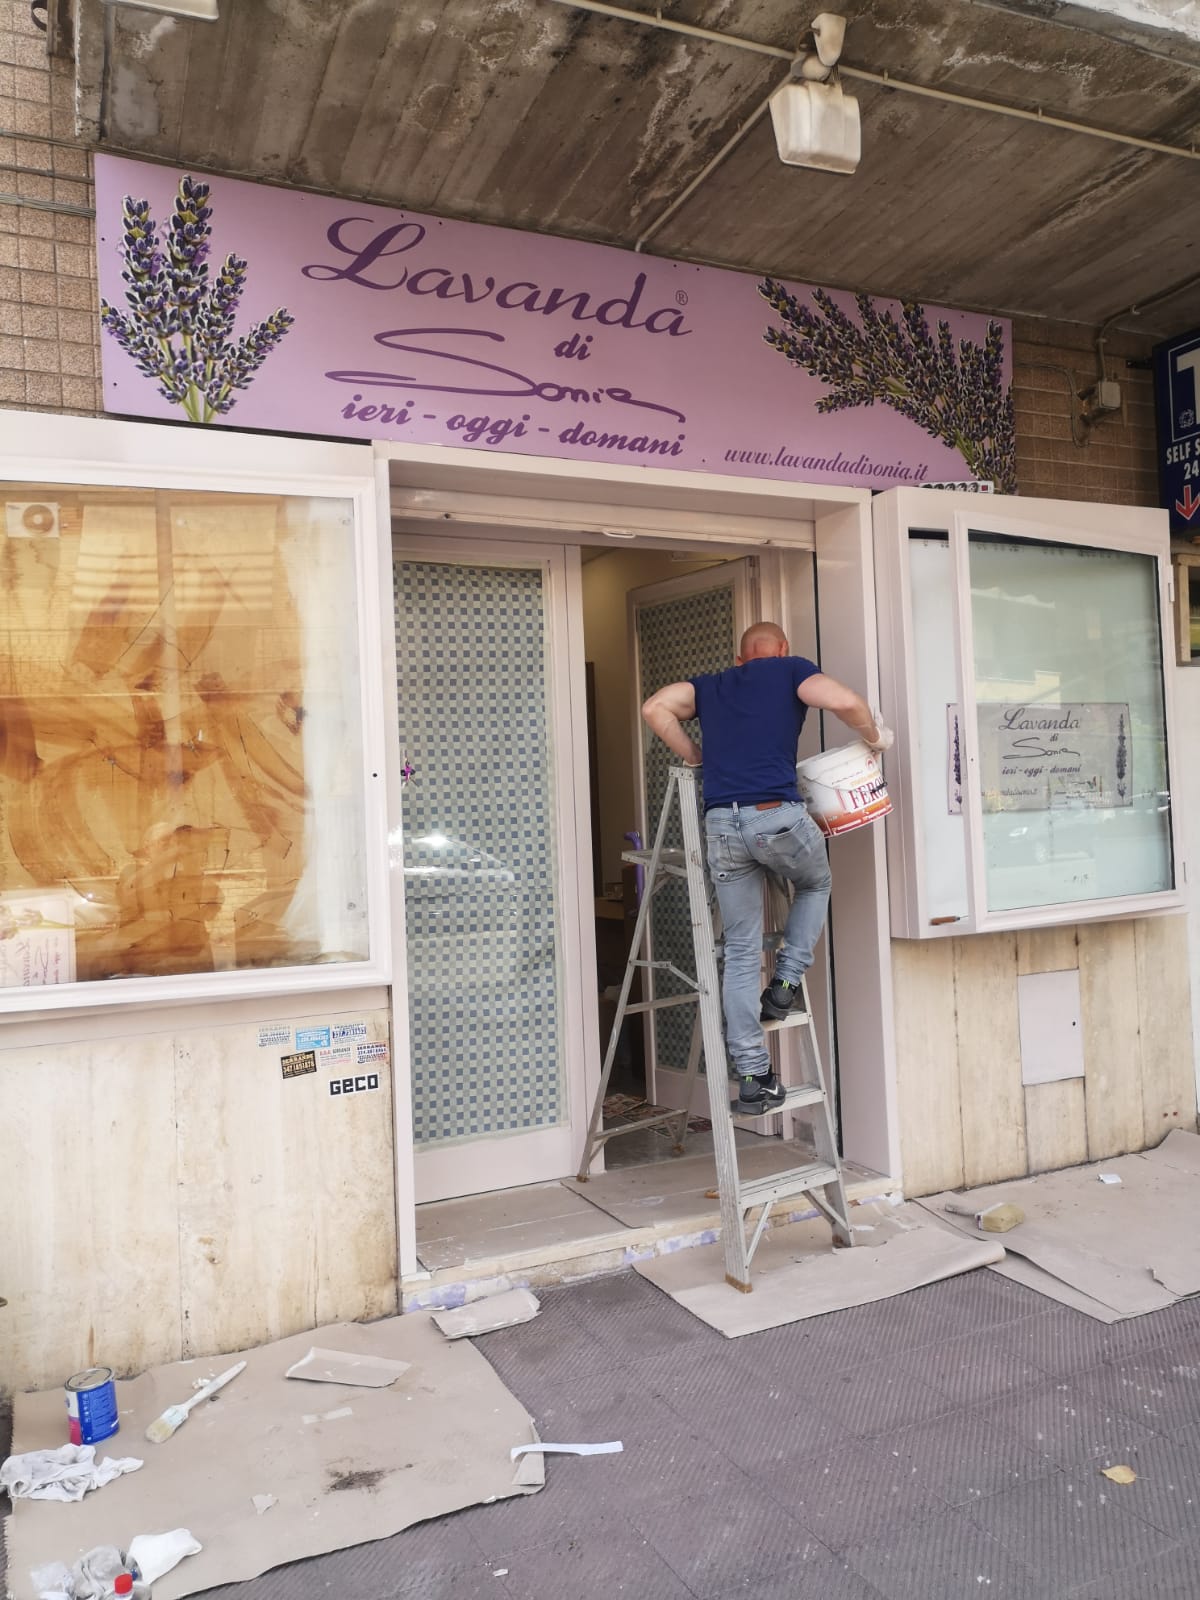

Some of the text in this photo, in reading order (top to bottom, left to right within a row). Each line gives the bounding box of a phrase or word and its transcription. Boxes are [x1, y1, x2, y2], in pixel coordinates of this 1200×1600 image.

[301, 217, 693, 336] Lavanda
[553, 333, 593, 360] di
[341, 394, 414, 425] ieri
[446, 414, 530, 445] oggi
[559, 421, 686, 456] domani
[725, 446, 928, 481] www.lavandadisonia.it
[1166, 442, 1191, 465] SELF
[999, 707, 1080, 730] Lavanda
